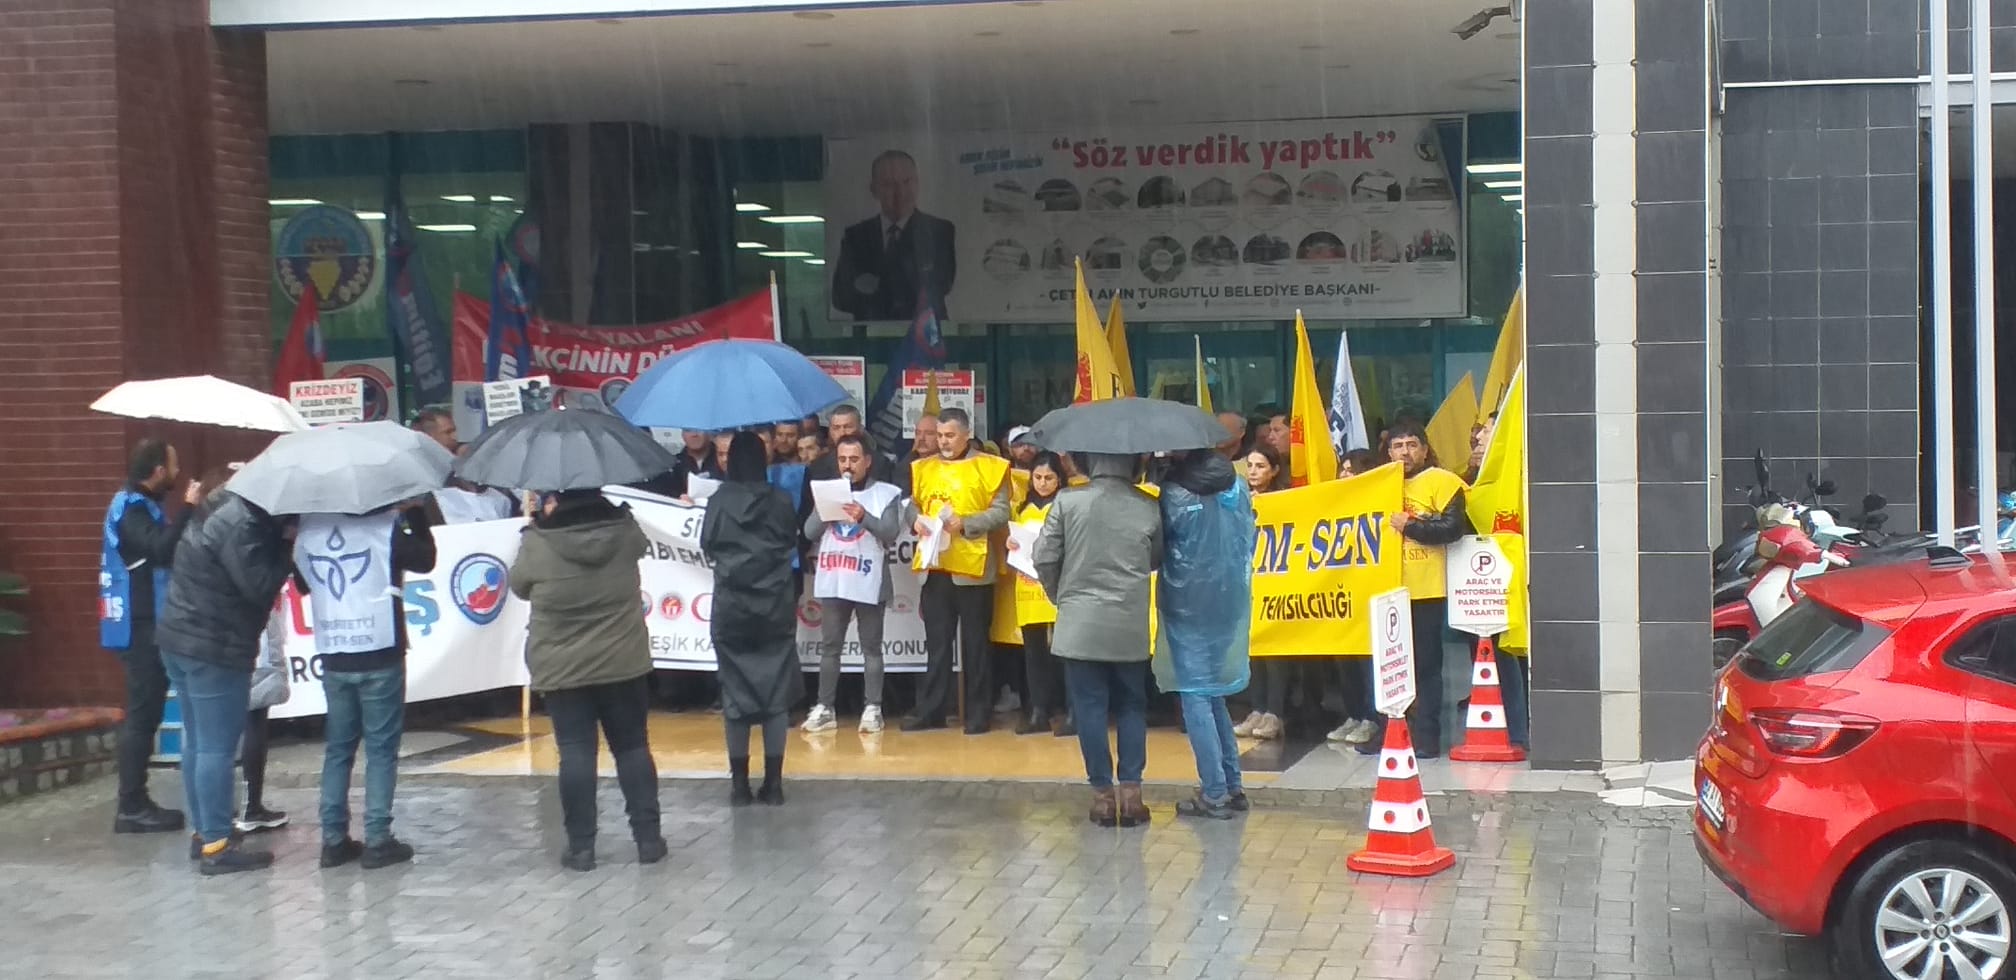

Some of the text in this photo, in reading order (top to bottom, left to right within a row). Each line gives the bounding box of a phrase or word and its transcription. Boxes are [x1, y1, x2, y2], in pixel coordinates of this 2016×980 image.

[1135, 133, 1251, 168] verdik
[1138, 285, 1220, 300] TURGUTLU
[1224, 282, 1300, 298] BELEDİYE
[597, 320, 704, 347] YALANI
[1466, 578, 1490, 586] ARAÇ
[1454, 587, 1510, 596] MOTORSİKLE
[1457, 598, 1480, 606] PARK
[1463, 608, 1505, 617] YASAKTIR
